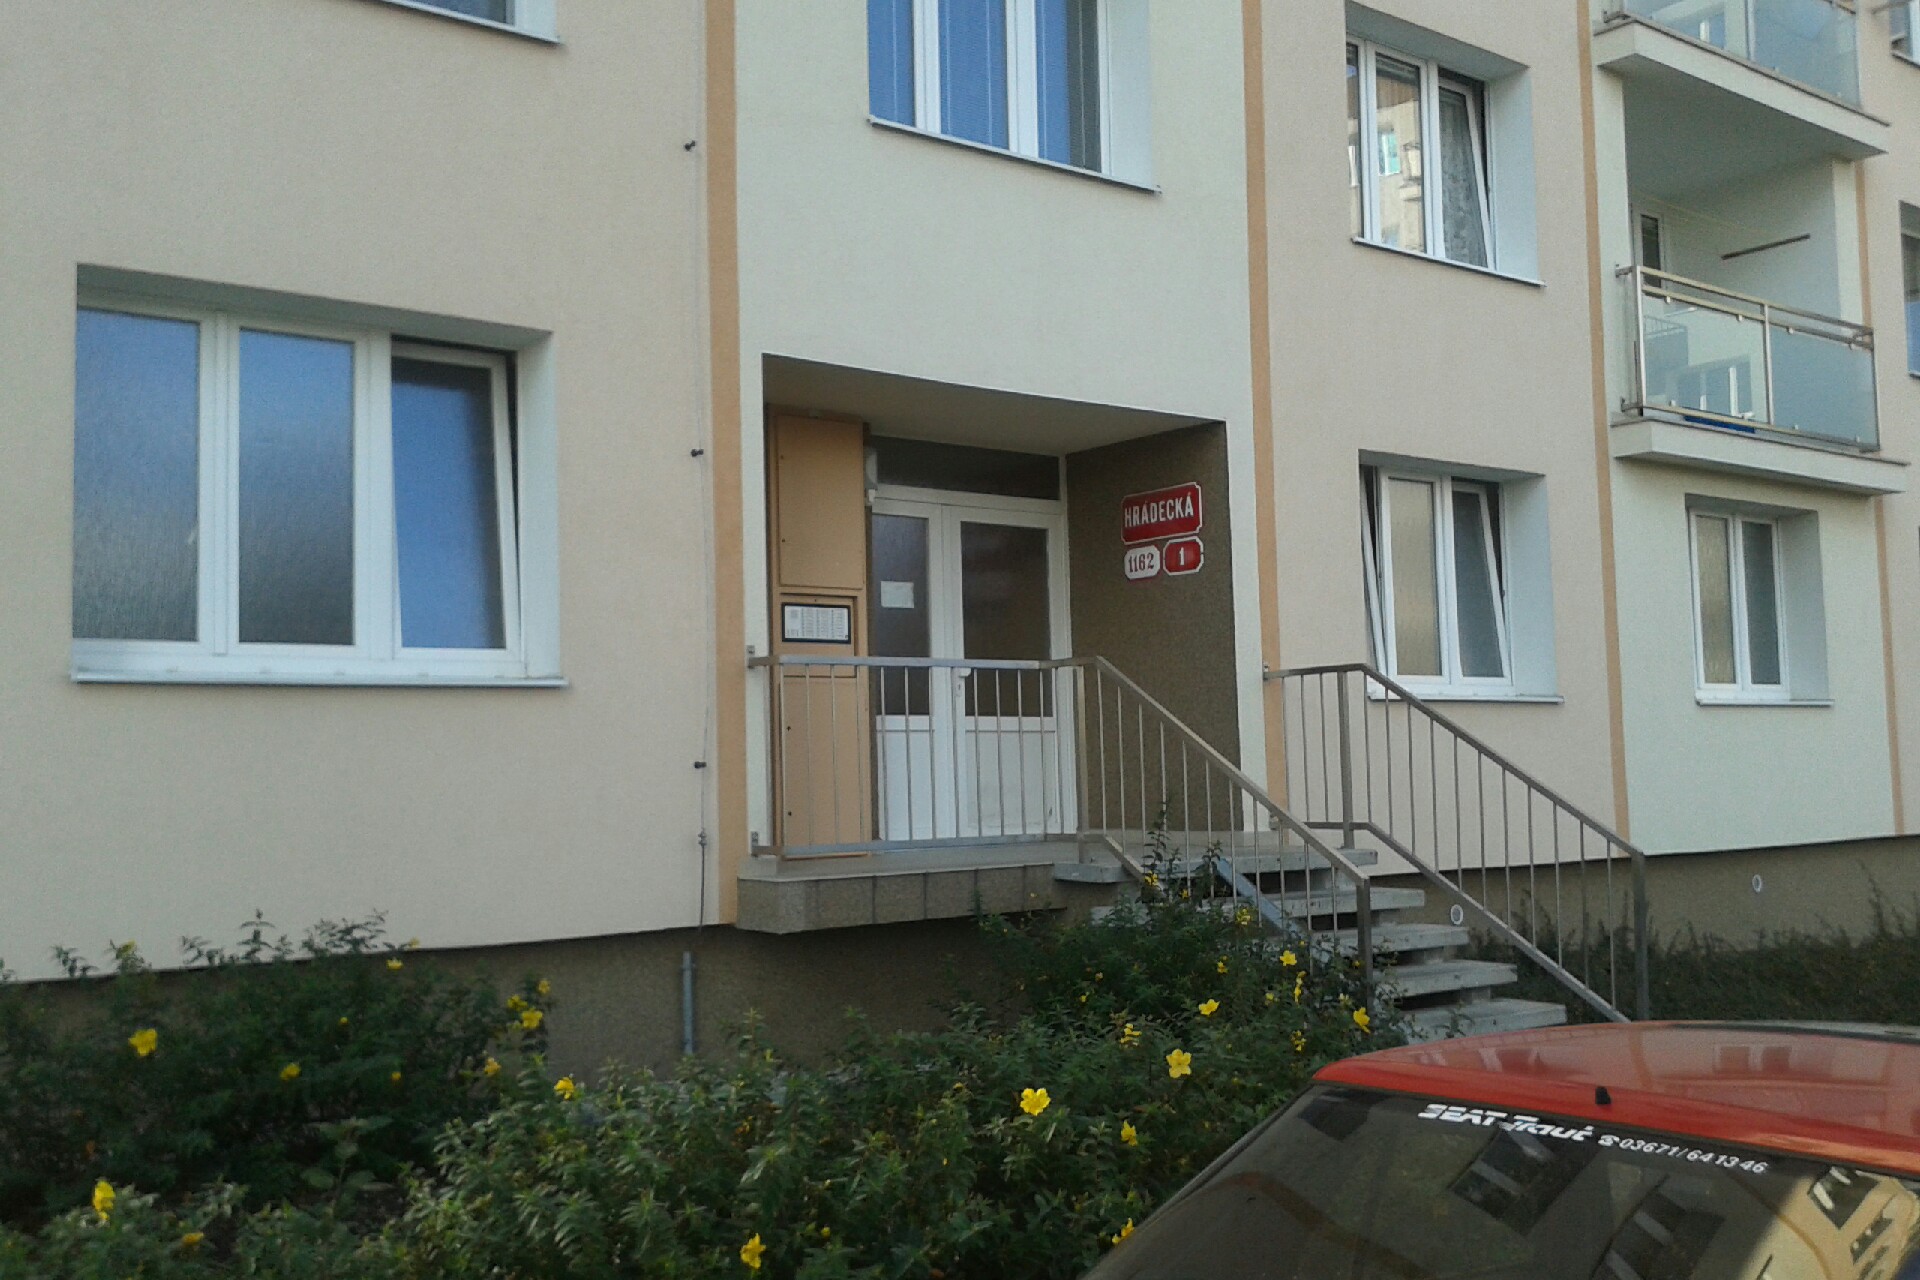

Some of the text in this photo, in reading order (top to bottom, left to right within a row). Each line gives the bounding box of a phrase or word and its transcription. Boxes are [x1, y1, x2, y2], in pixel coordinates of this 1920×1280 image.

[1124, 492, 1194, 528] HRÁDECKÁ
[1128, 552, 1155, 573] 1162
[1179, 546, 1186, 566] 1
[1417, 1103, 1508, 1126] SEAT
